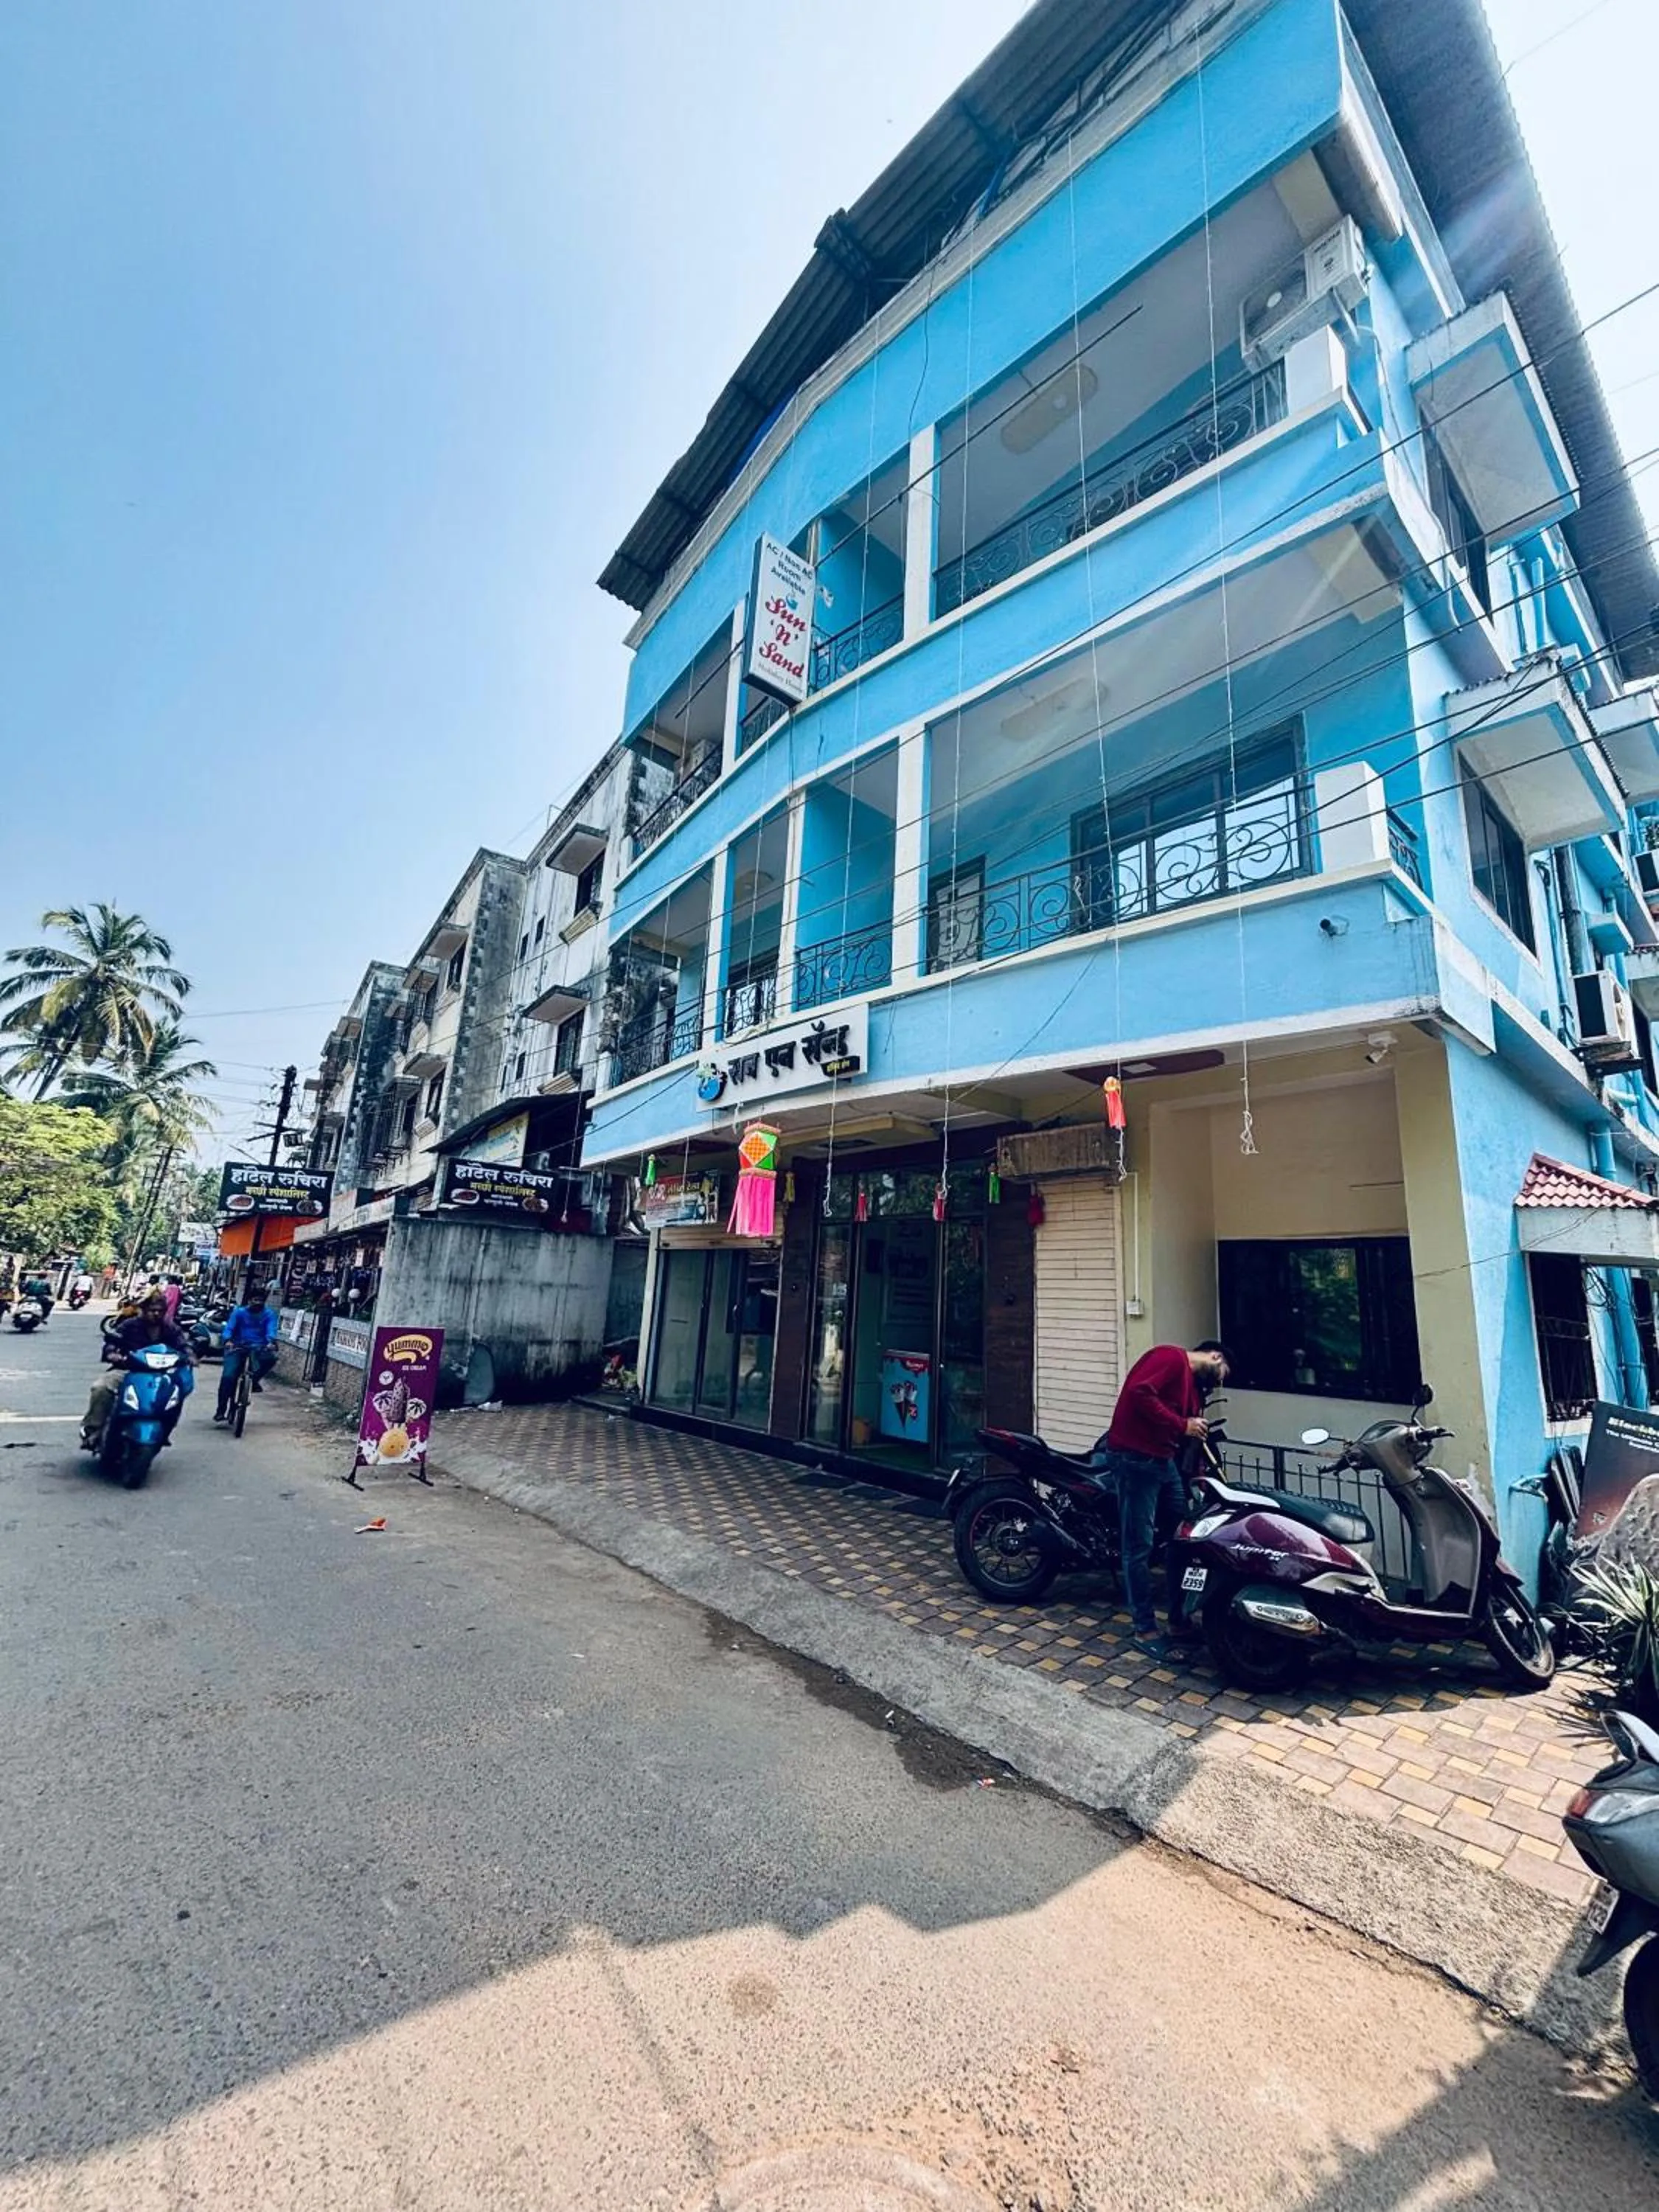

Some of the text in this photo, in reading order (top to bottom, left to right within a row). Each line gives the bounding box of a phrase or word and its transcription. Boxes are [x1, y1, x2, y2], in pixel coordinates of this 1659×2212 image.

[766, 542, 779, 555] AC
[801, 567, 813, 580] AC
[765, 595, 807, 632] Sun
[759, 641, 804, 678] Sand
[728, 1053, 759, 1085] सन
[765, 1041, 796, 1077] एन
[231, 1165, 327, 1189] हॉटेल रुचिरा
[455, 1162, 554, 1189] हॉटेल रुचिरा
